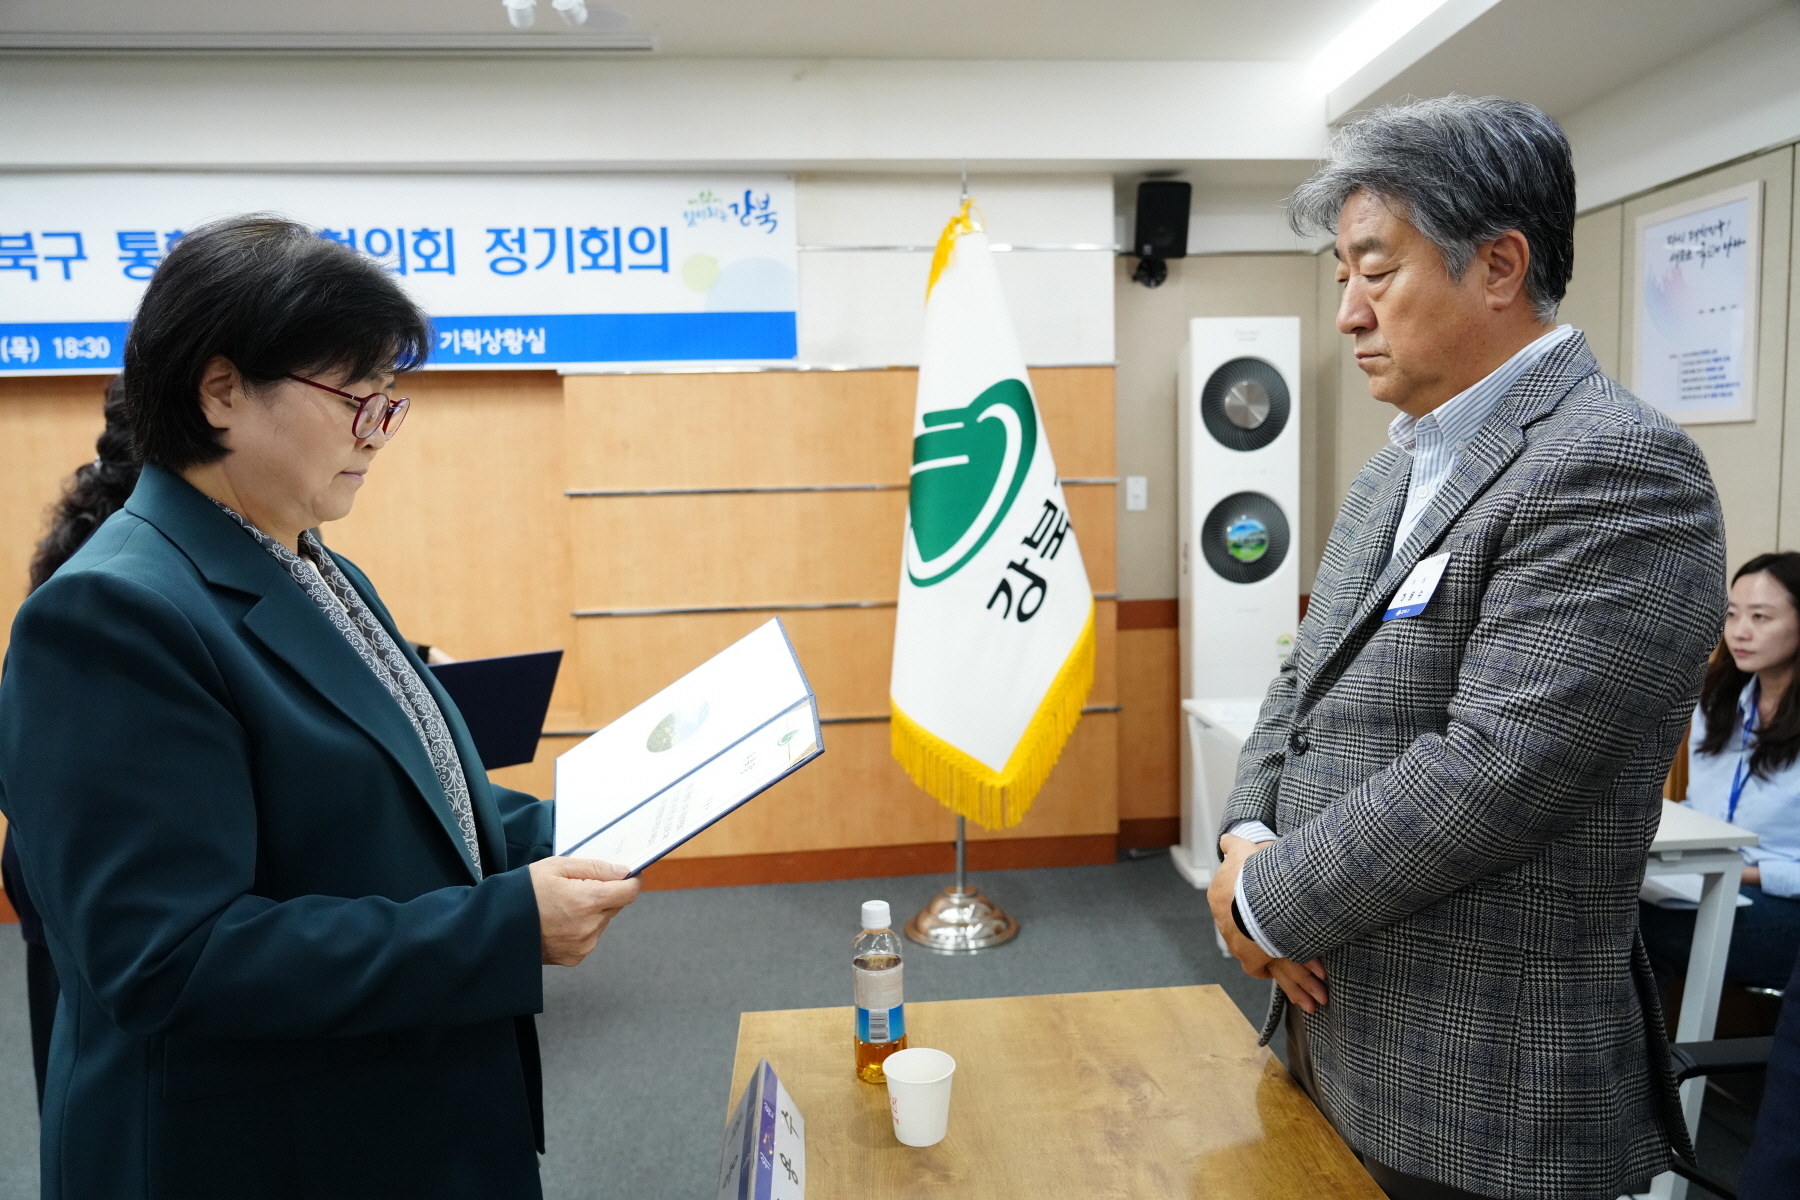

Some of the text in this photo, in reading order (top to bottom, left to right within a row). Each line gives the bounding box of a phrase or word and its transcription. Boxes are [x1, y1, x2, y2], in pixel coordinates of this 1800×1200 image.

[728, 189, 778, 234] 강북
[485, 226, 669, 276] 정기회의
[52, 336, 111, 360] 18:30
[439, 327, 546, 356] 기획상황실
